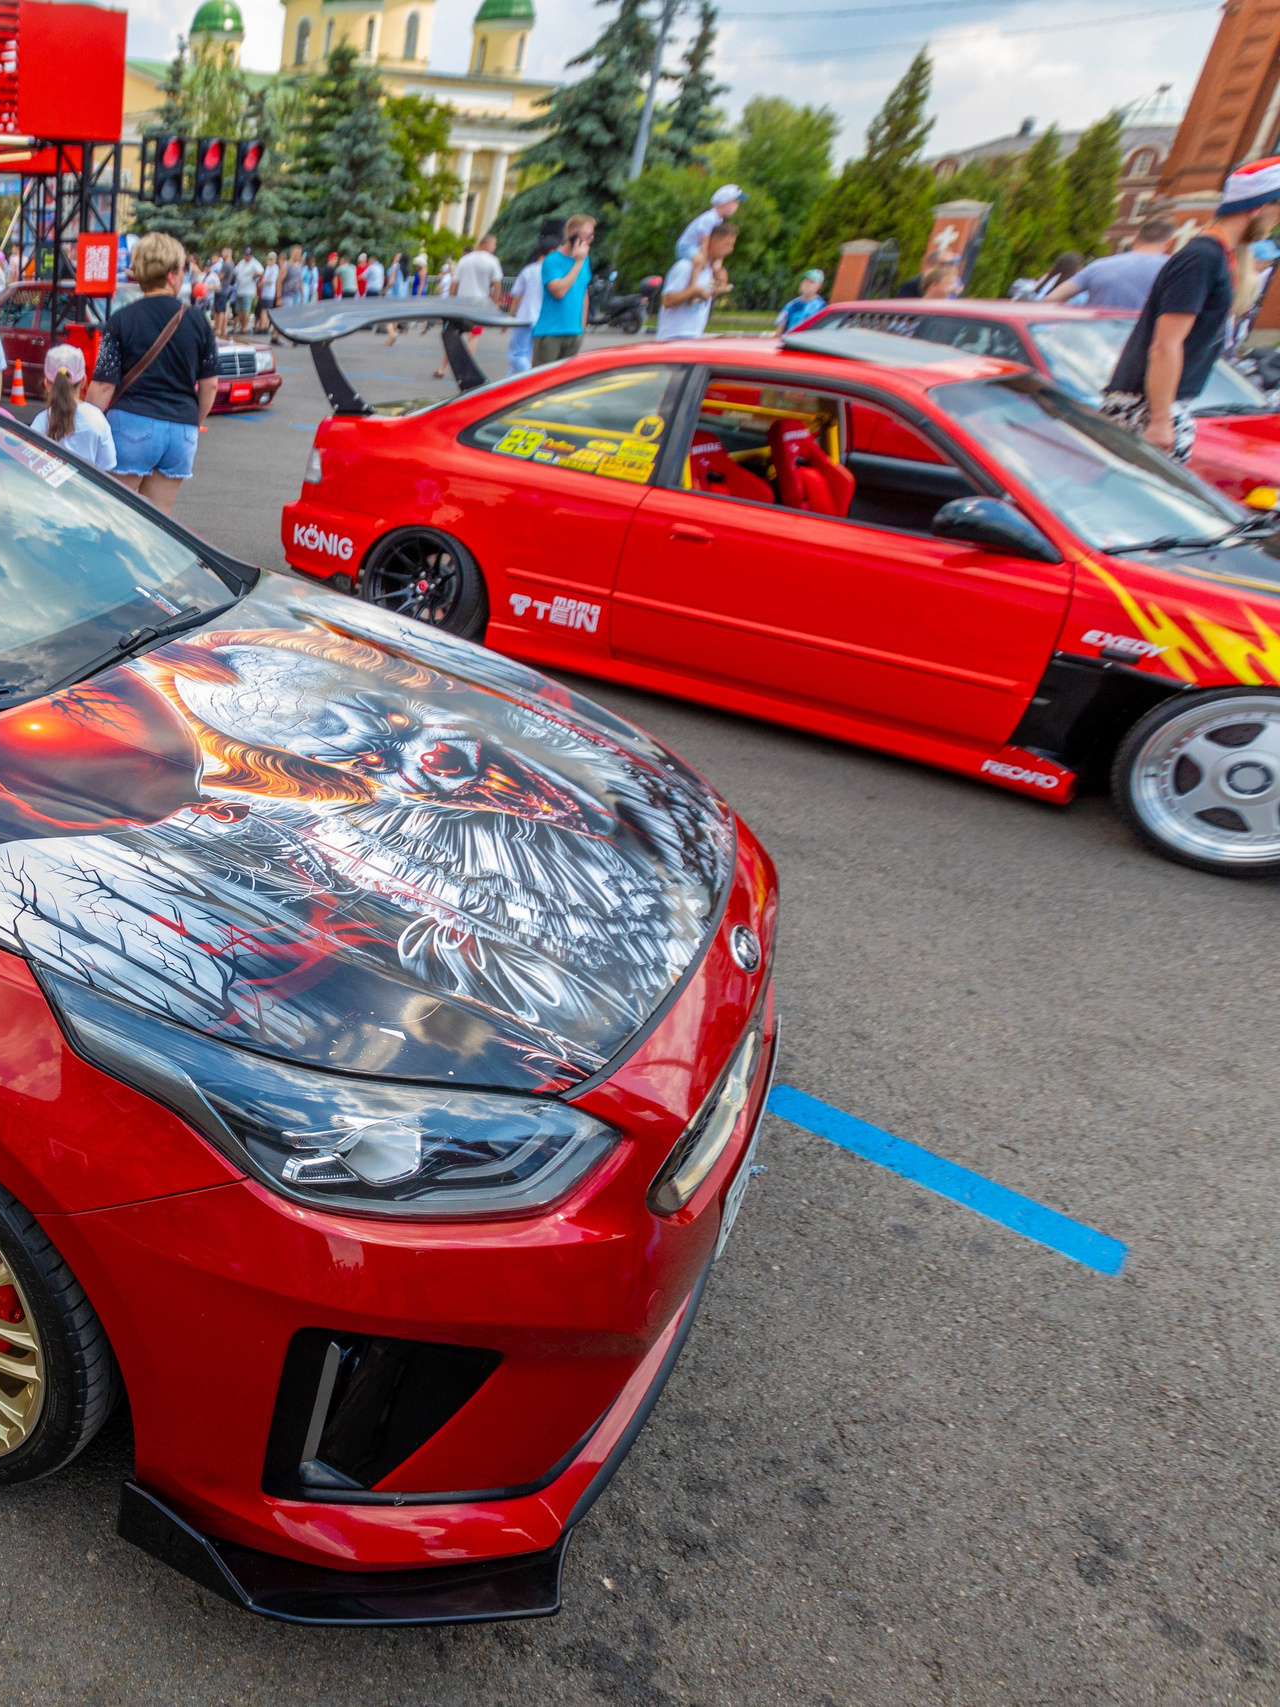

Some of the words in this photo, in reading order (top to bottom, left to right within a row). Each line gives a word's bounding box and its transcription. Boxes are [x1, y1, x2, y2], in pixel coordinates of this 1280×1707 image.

[497, 428, 545, 456] 23
[691, 441, 723, 456] BRIDE
[293, 522, 354, 561] KÖNIG
[531, 600, 600, 633] TEIN
[1080, 629, 1170, 658] EXEDY
[980, 759, 1059, 789] RECARO
